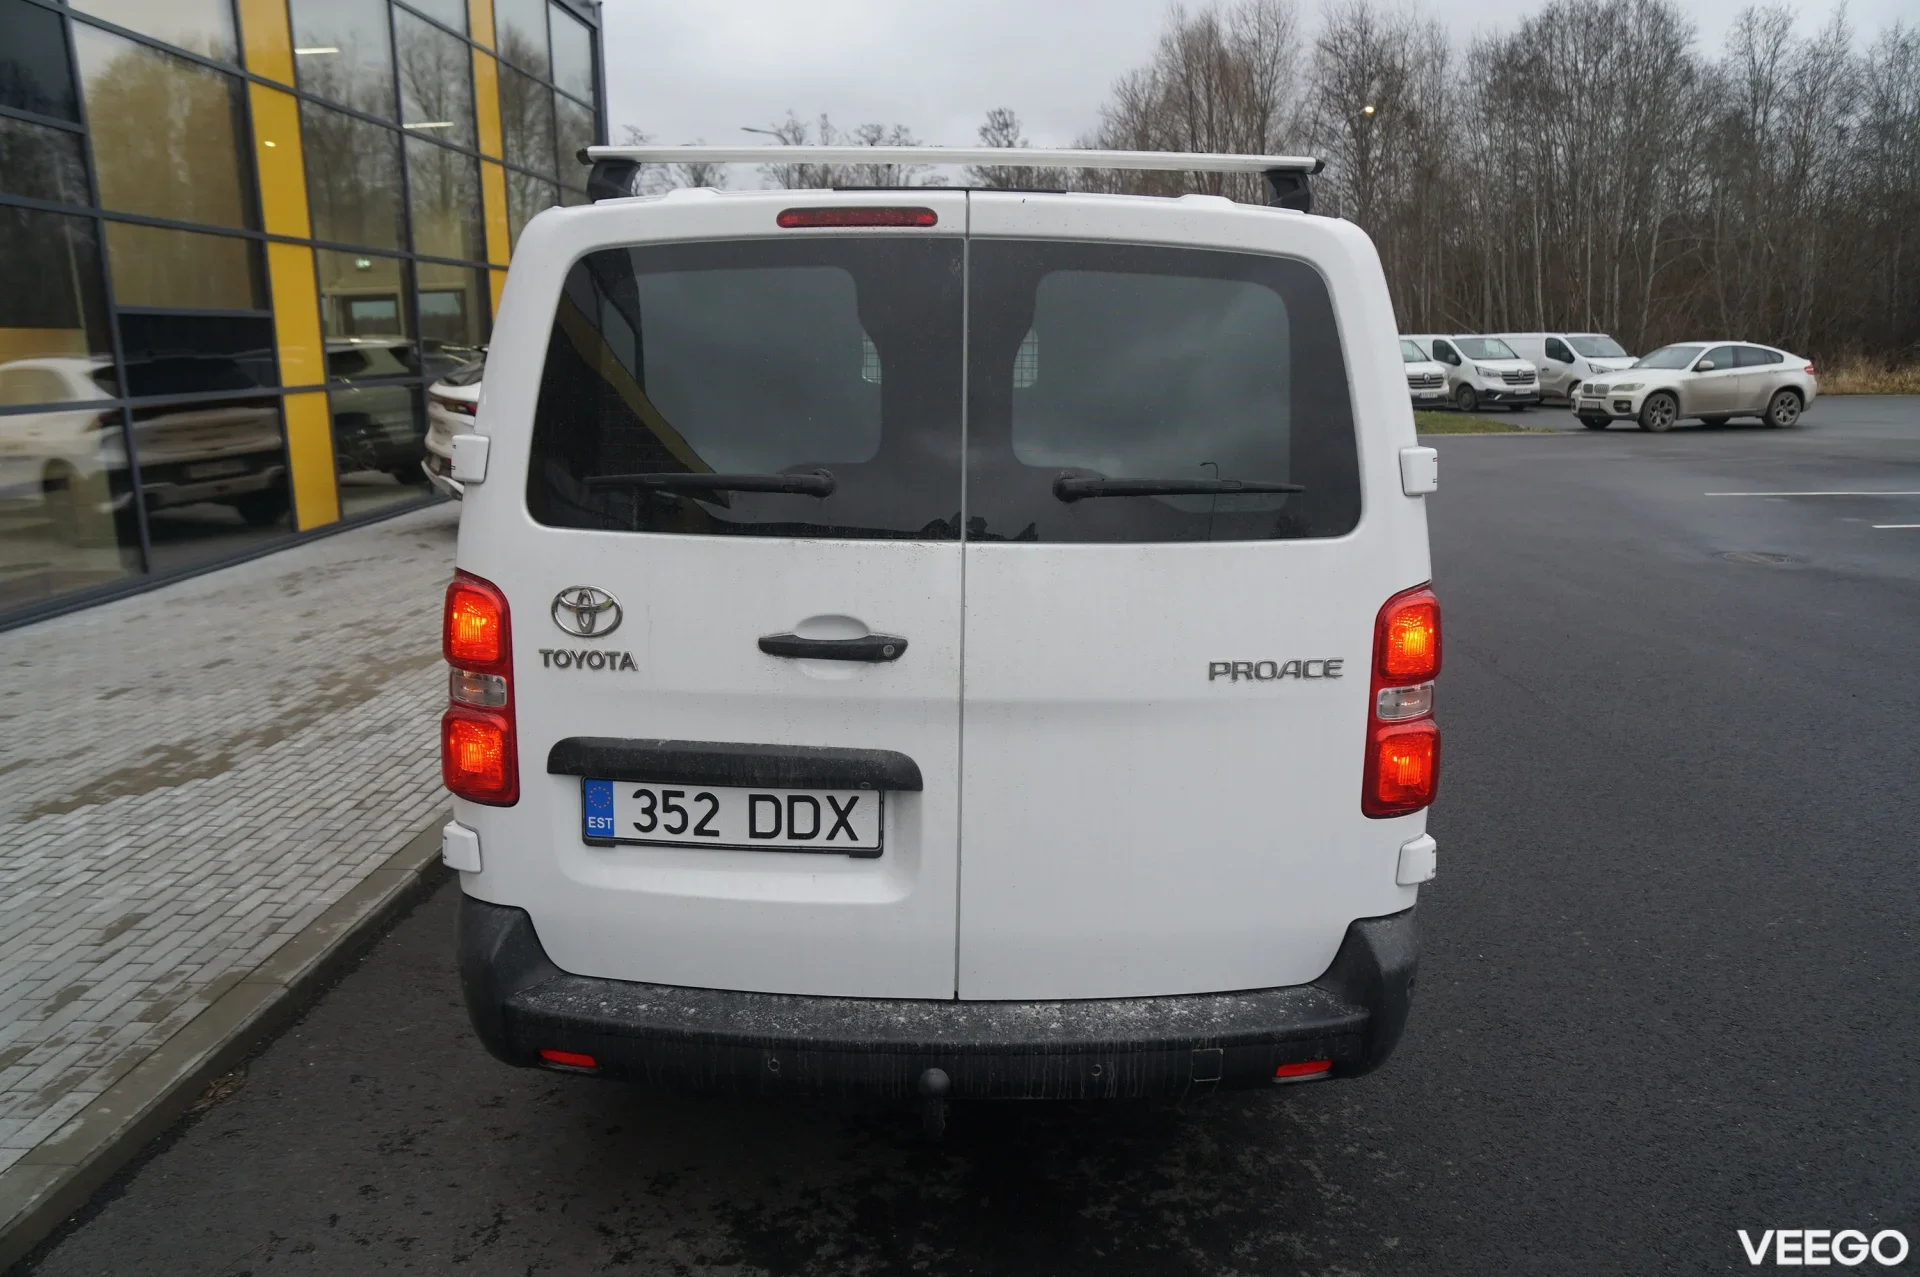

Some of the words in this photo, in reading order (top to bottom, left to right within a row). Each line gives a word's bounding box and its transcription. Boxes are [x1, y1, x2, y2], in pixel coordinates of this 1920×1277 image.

[539, 649, 638, 671] TOYOTA
[1209, 658, 1344, 681] PROACE
[588, 816, 613, 830] EST
[632, 788, 720, 836] 352
[748, 794, 859, 841] DDX
